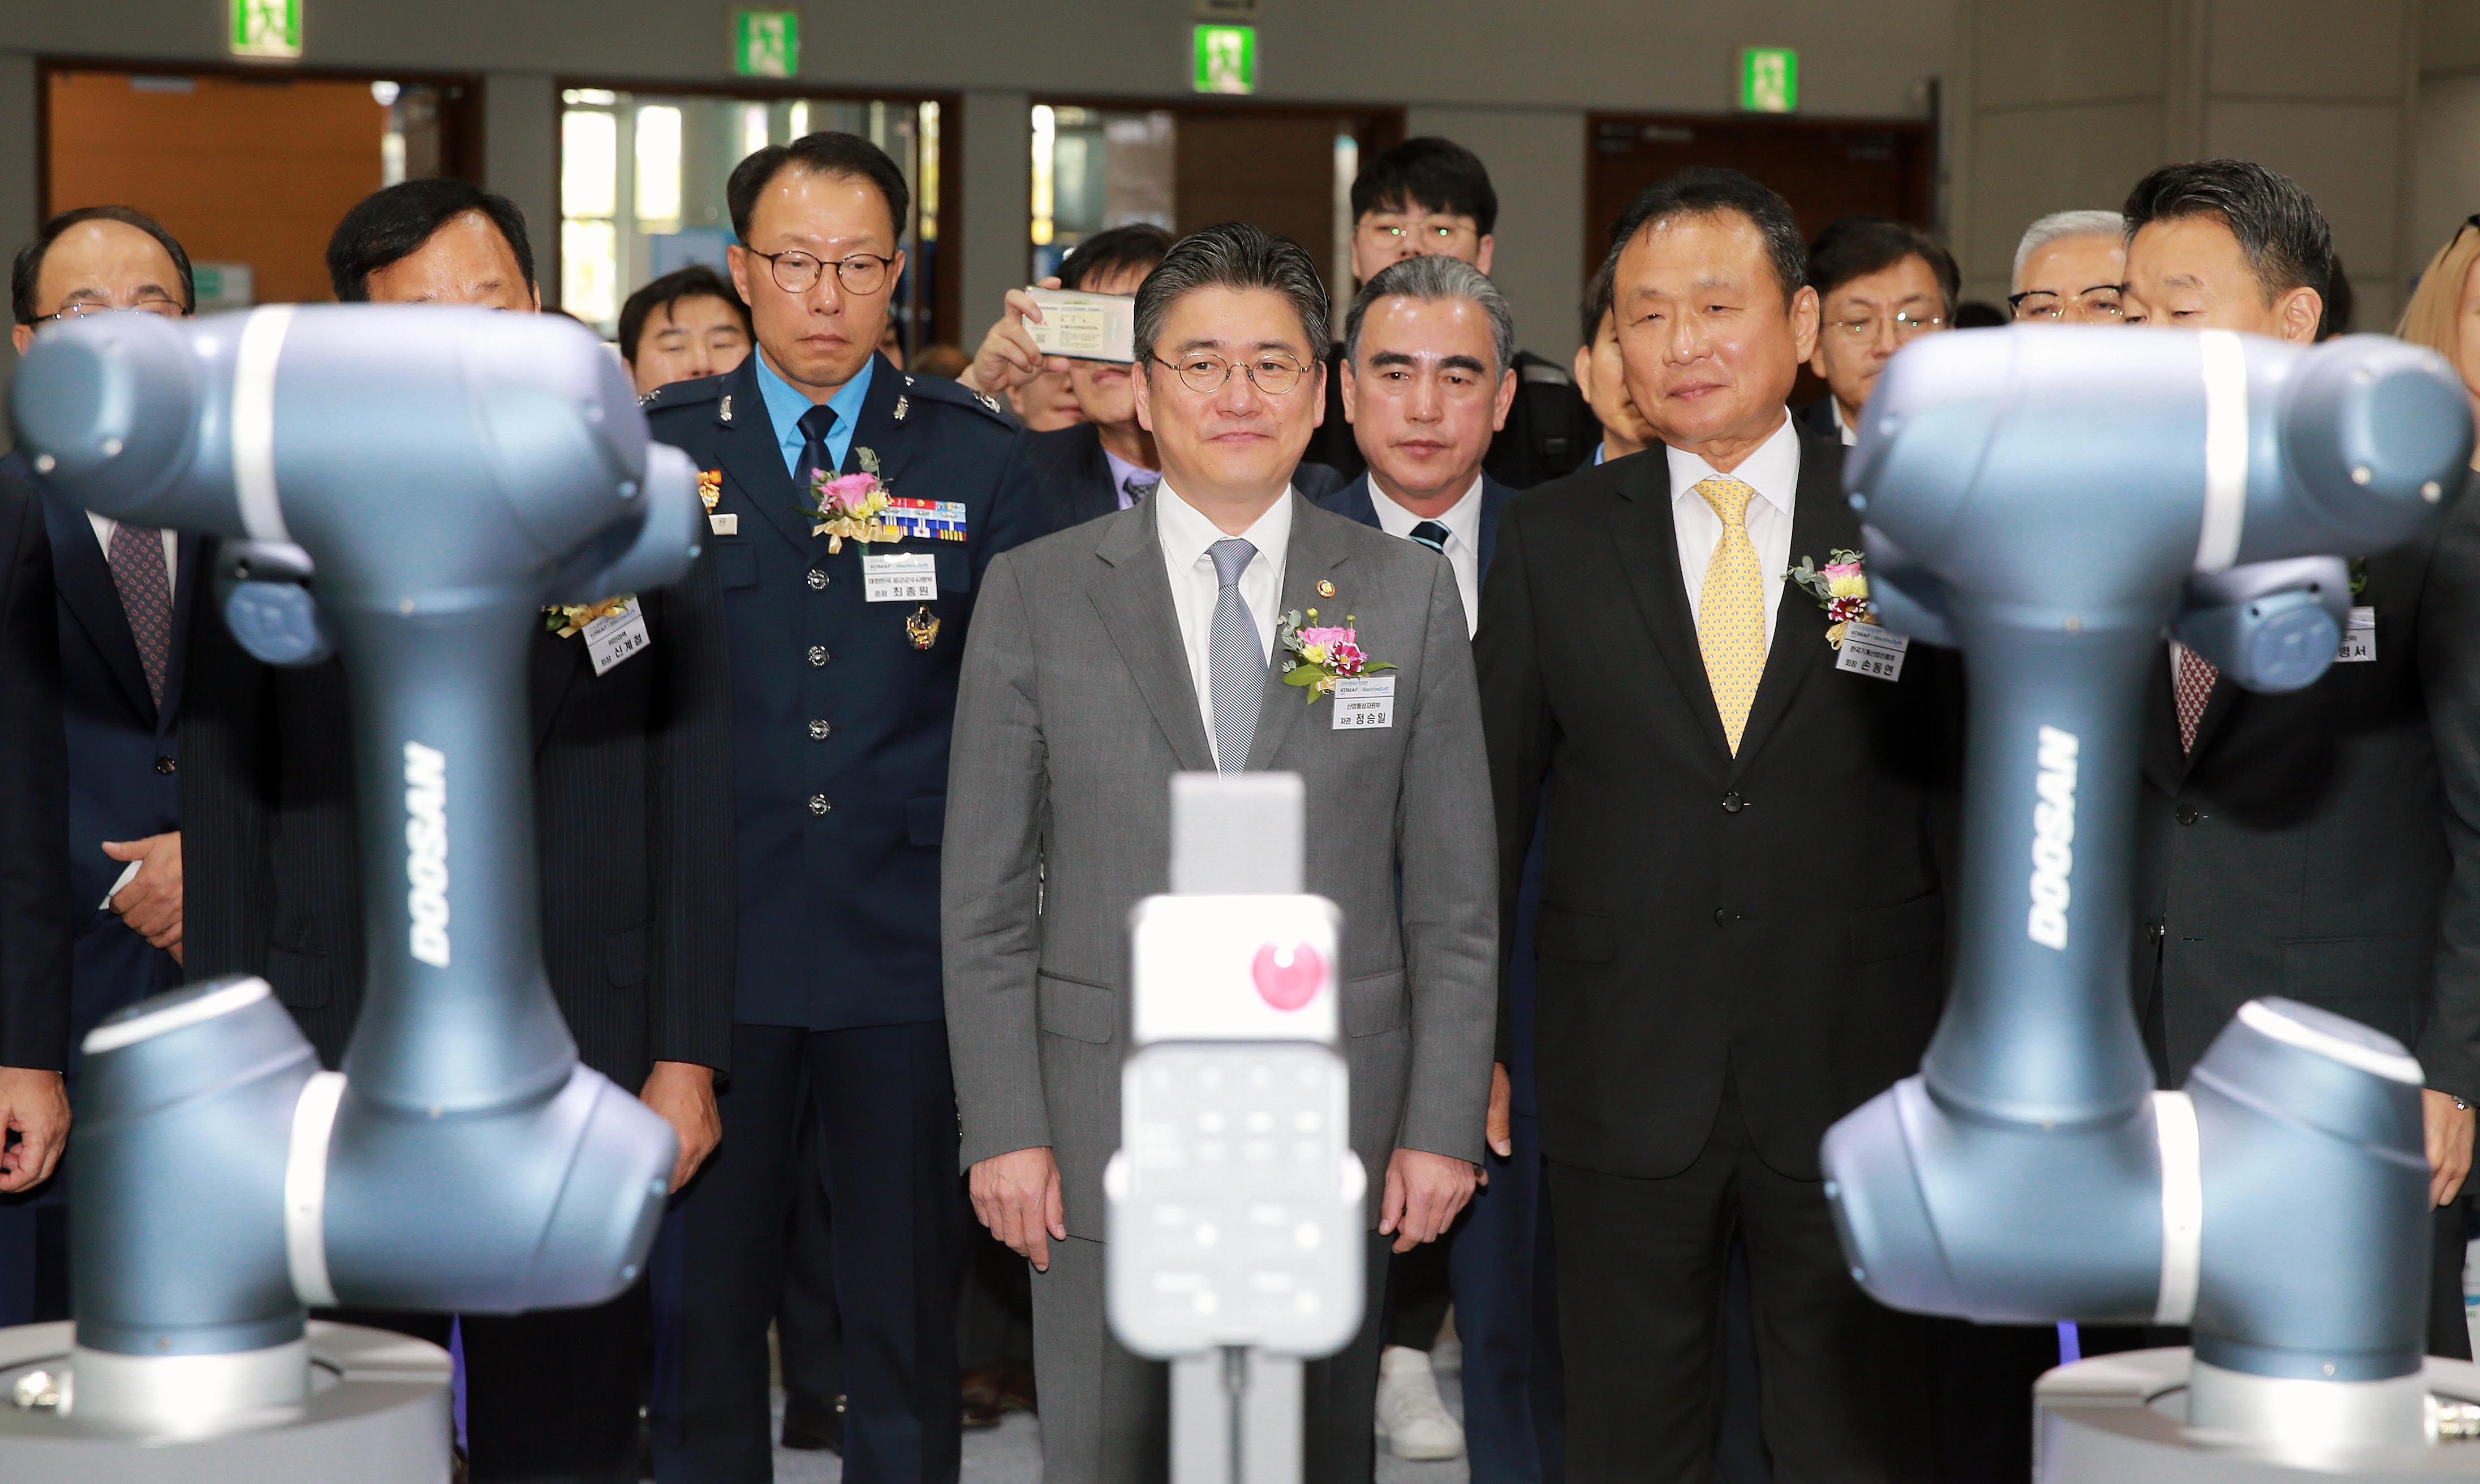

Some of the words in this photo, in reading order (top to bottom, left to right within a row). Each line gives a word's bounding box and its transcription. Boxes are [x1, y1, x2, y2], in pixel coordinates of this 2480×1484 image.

[1356, 712, 1386, 724] 정승일
[403, 740, 451, 969] DOOSAN
[2027, 724, 2079, 951] DOOSAN
